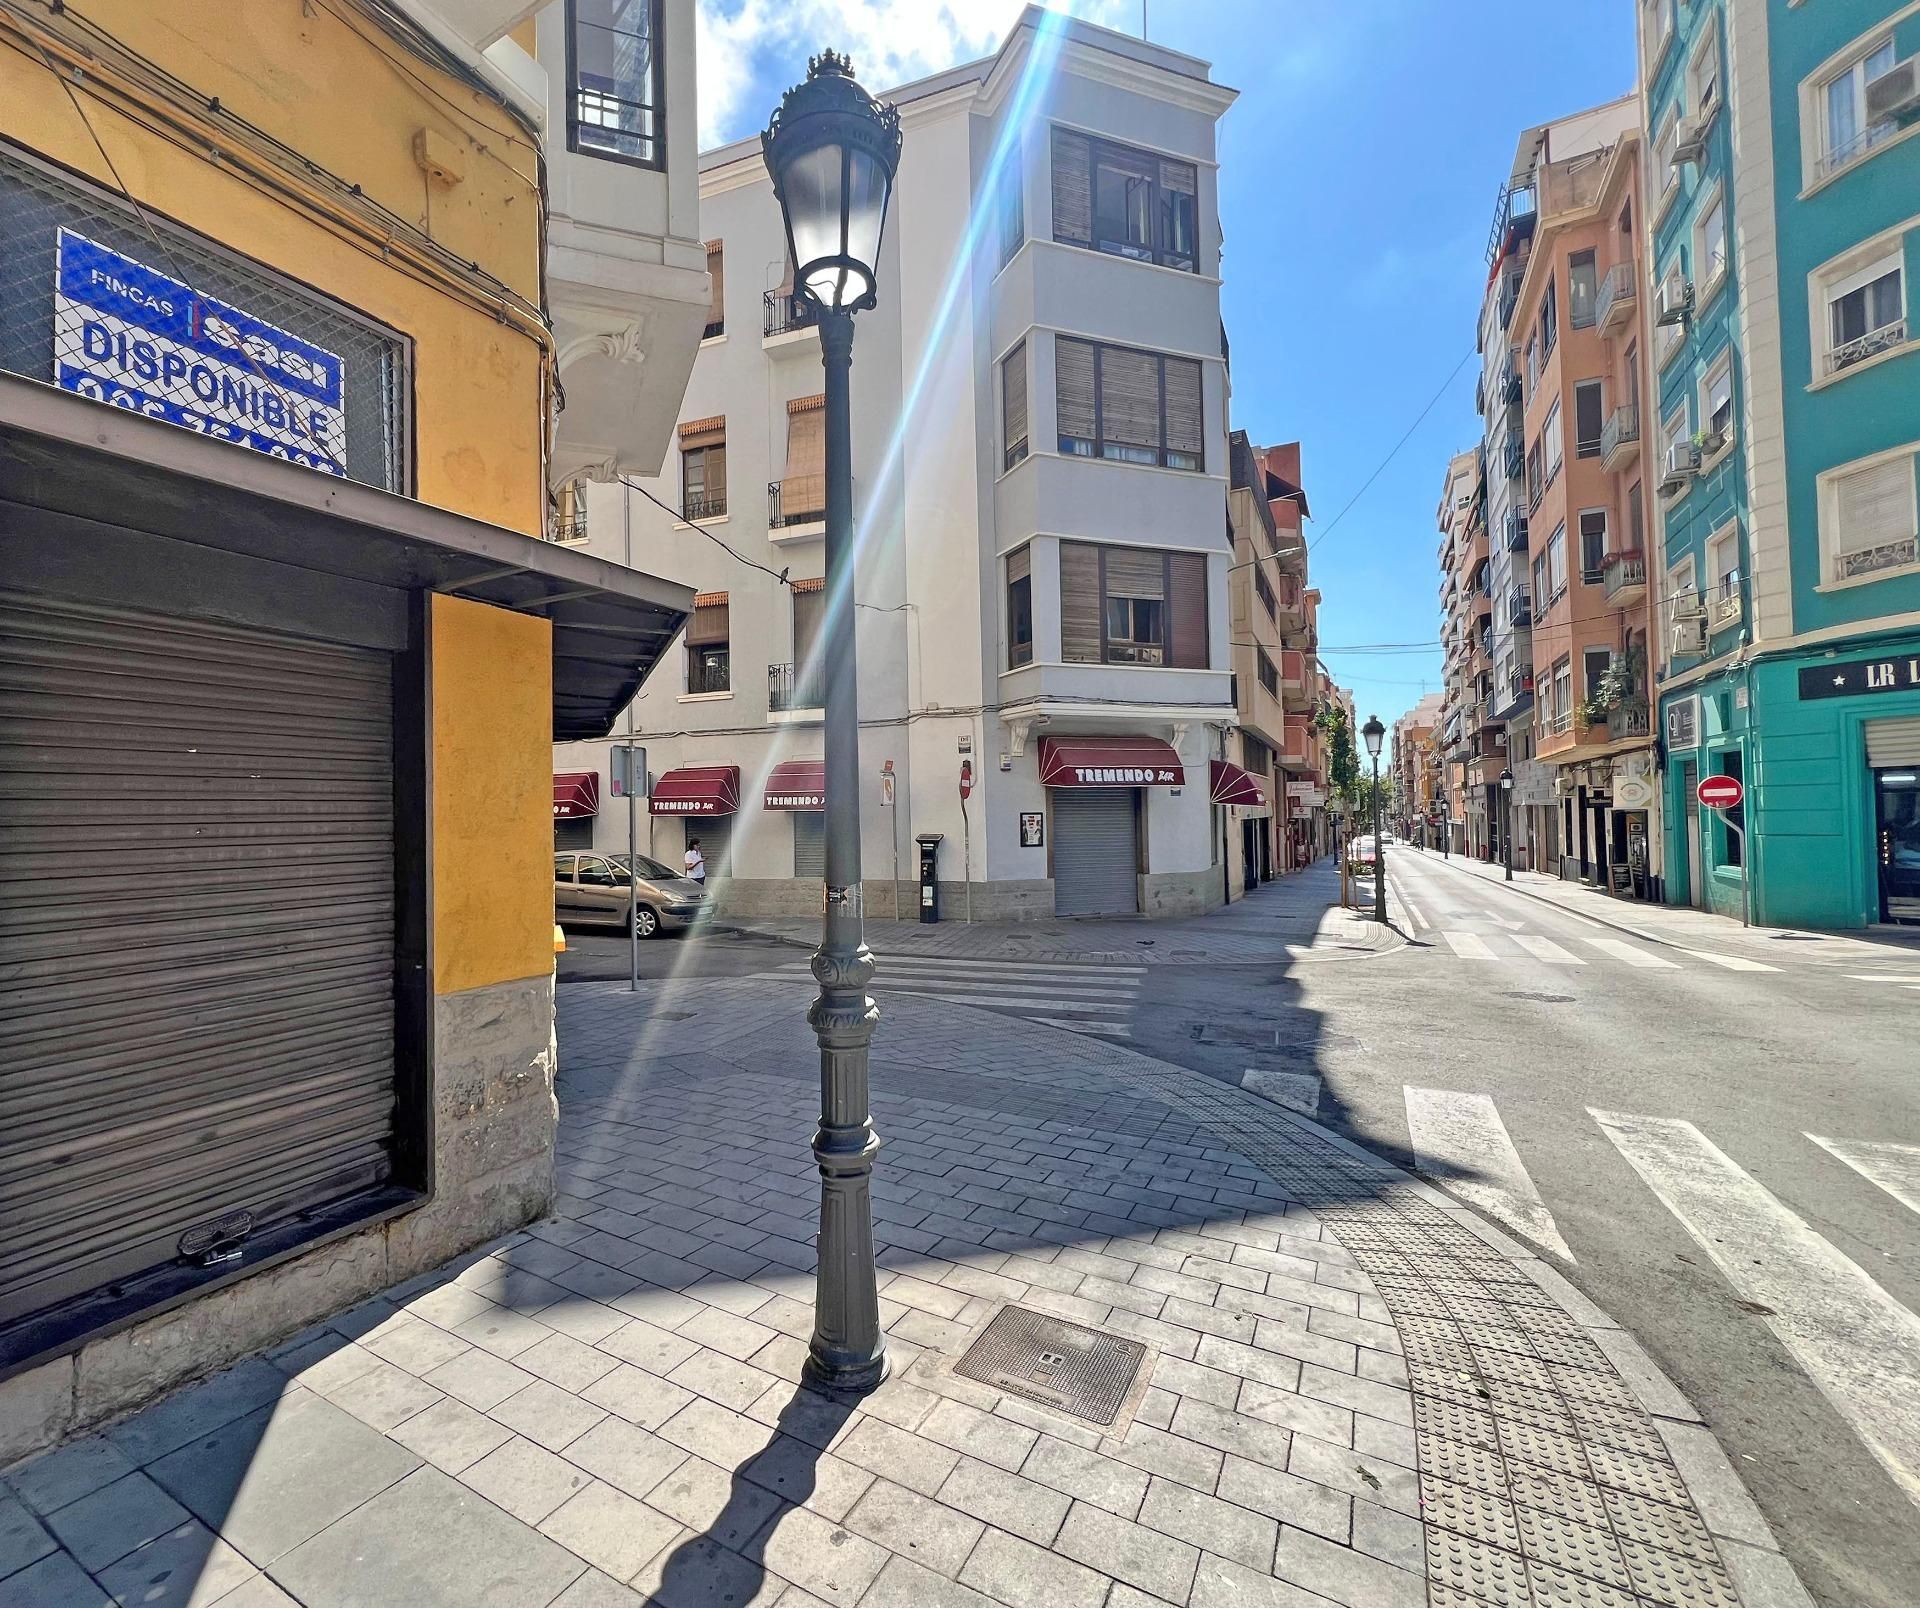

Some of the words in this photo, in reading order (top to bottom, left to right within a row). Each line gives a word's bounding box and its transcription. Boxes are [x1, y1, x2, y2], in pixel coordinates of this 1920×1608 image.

[91, 268, 174, 317] FINCAS
[82, 320, 330, 447] DISPONIBLE
[1075, 768, 1154, 782] TREMENDO
[1157, 770, 1175, 782] BAR
[654, 801, 701, 810] TREMENDO
[766, 796, 819, 806] TREMENDO
